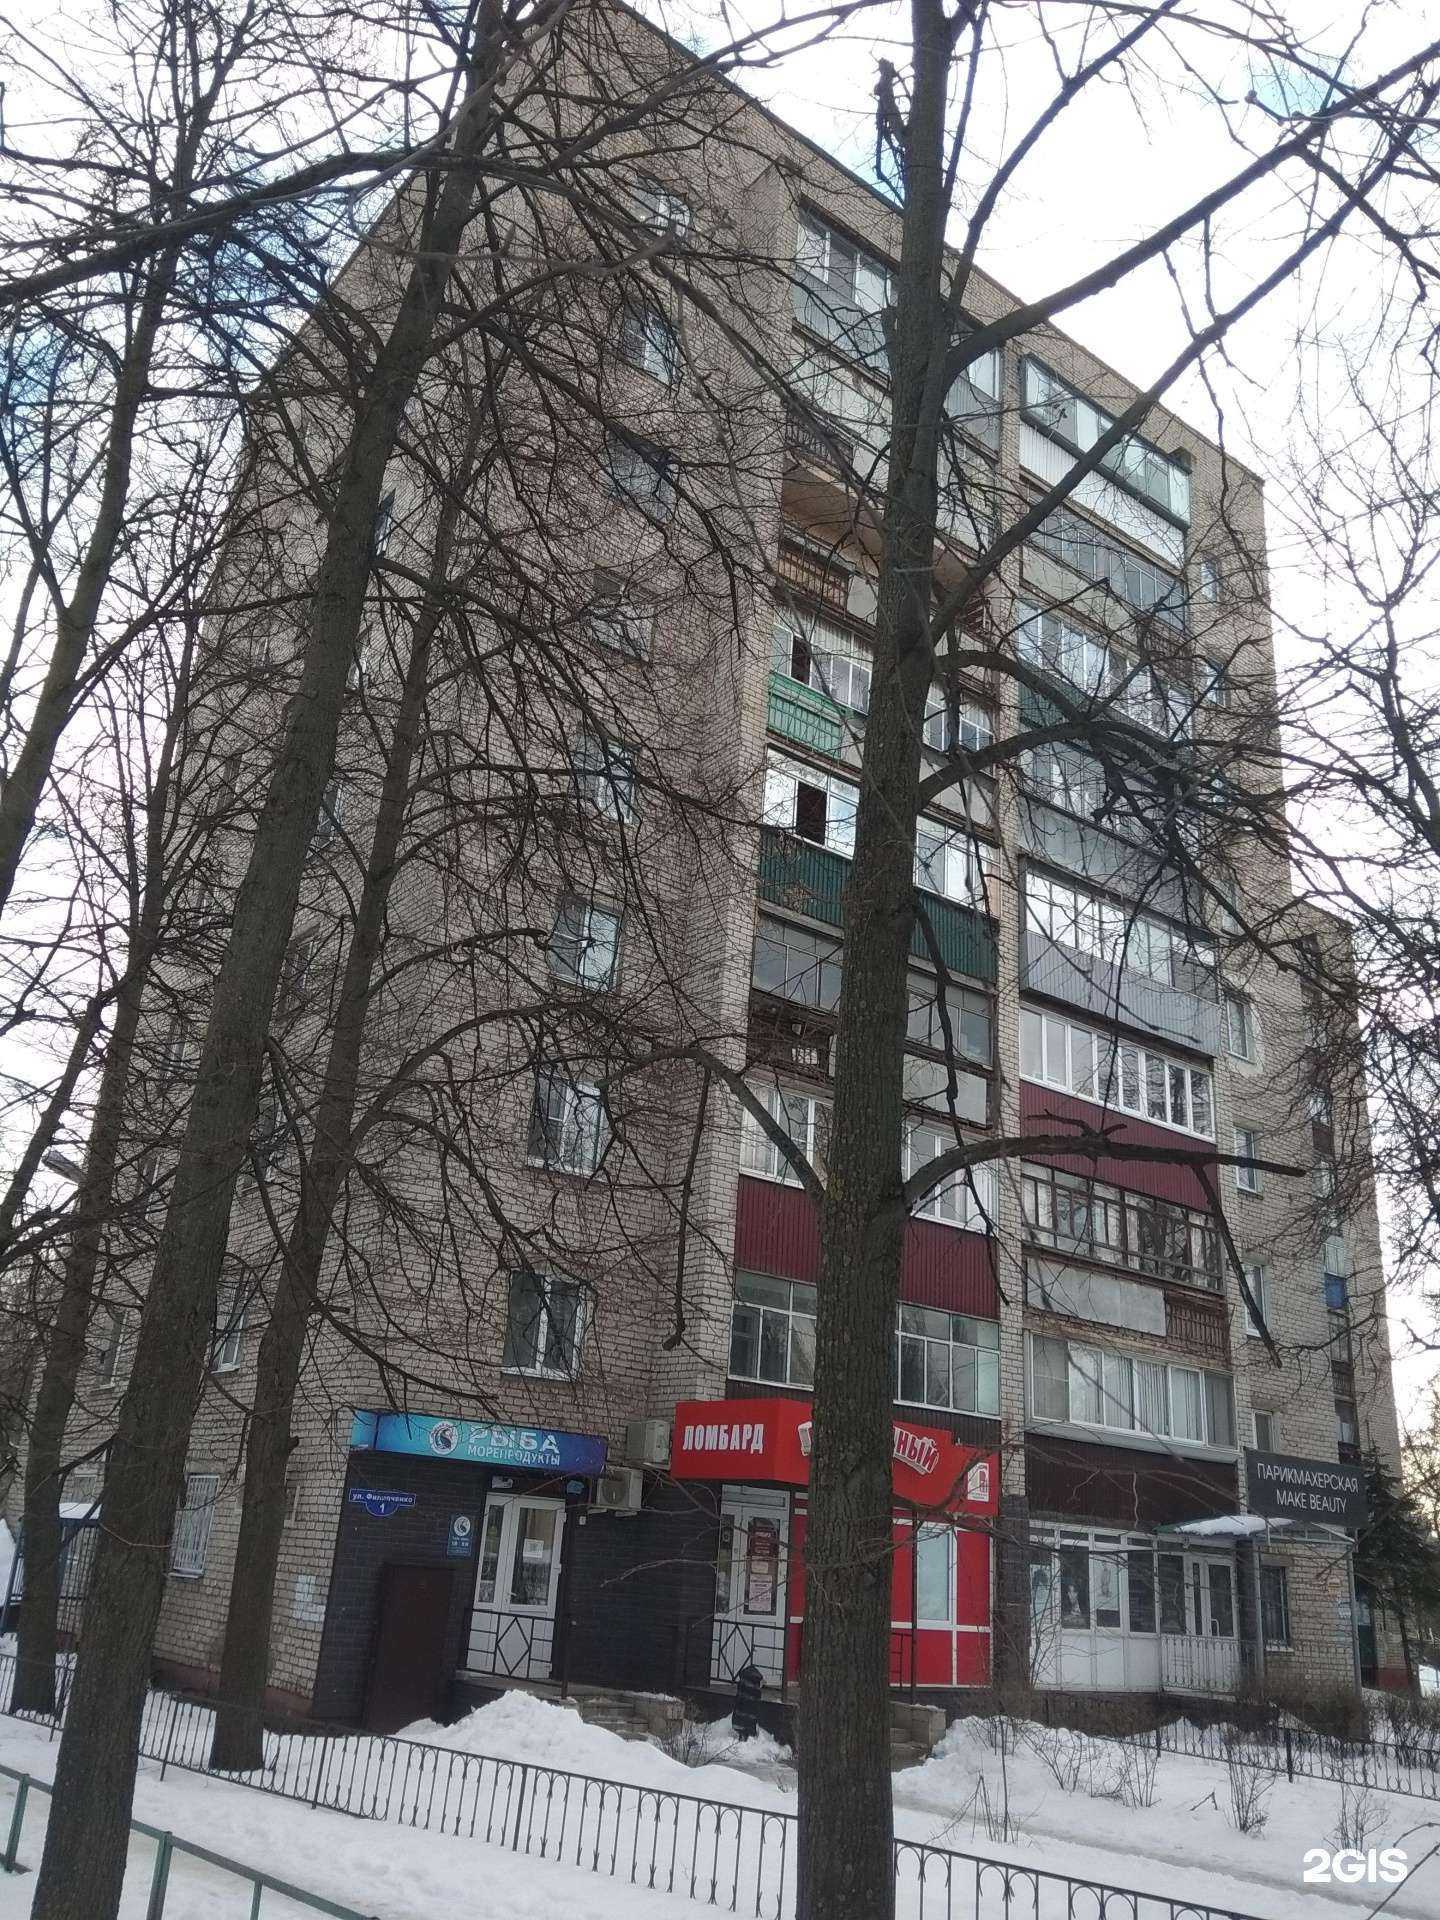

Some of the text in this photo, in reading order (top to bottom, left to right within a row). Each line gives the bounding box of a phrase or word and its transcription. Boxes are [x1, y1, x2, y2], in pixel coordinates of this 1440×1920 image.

[469, 1425, 560, 1454] РЫБА
[682, 1423, 764, 1454] ЛОМБАРД
[468, 1445, 560, 1466] МОРЕПРОДУКТЫ
[1257, 1463, 1359, 1493] ПАРИКМАХЕРСКАЯ
[352, 1493, 364, 1501] ул.
[380, 1503, 385, 1514] 1
[1276, 1489, 1346, 1513] MAKE BEAUTY
